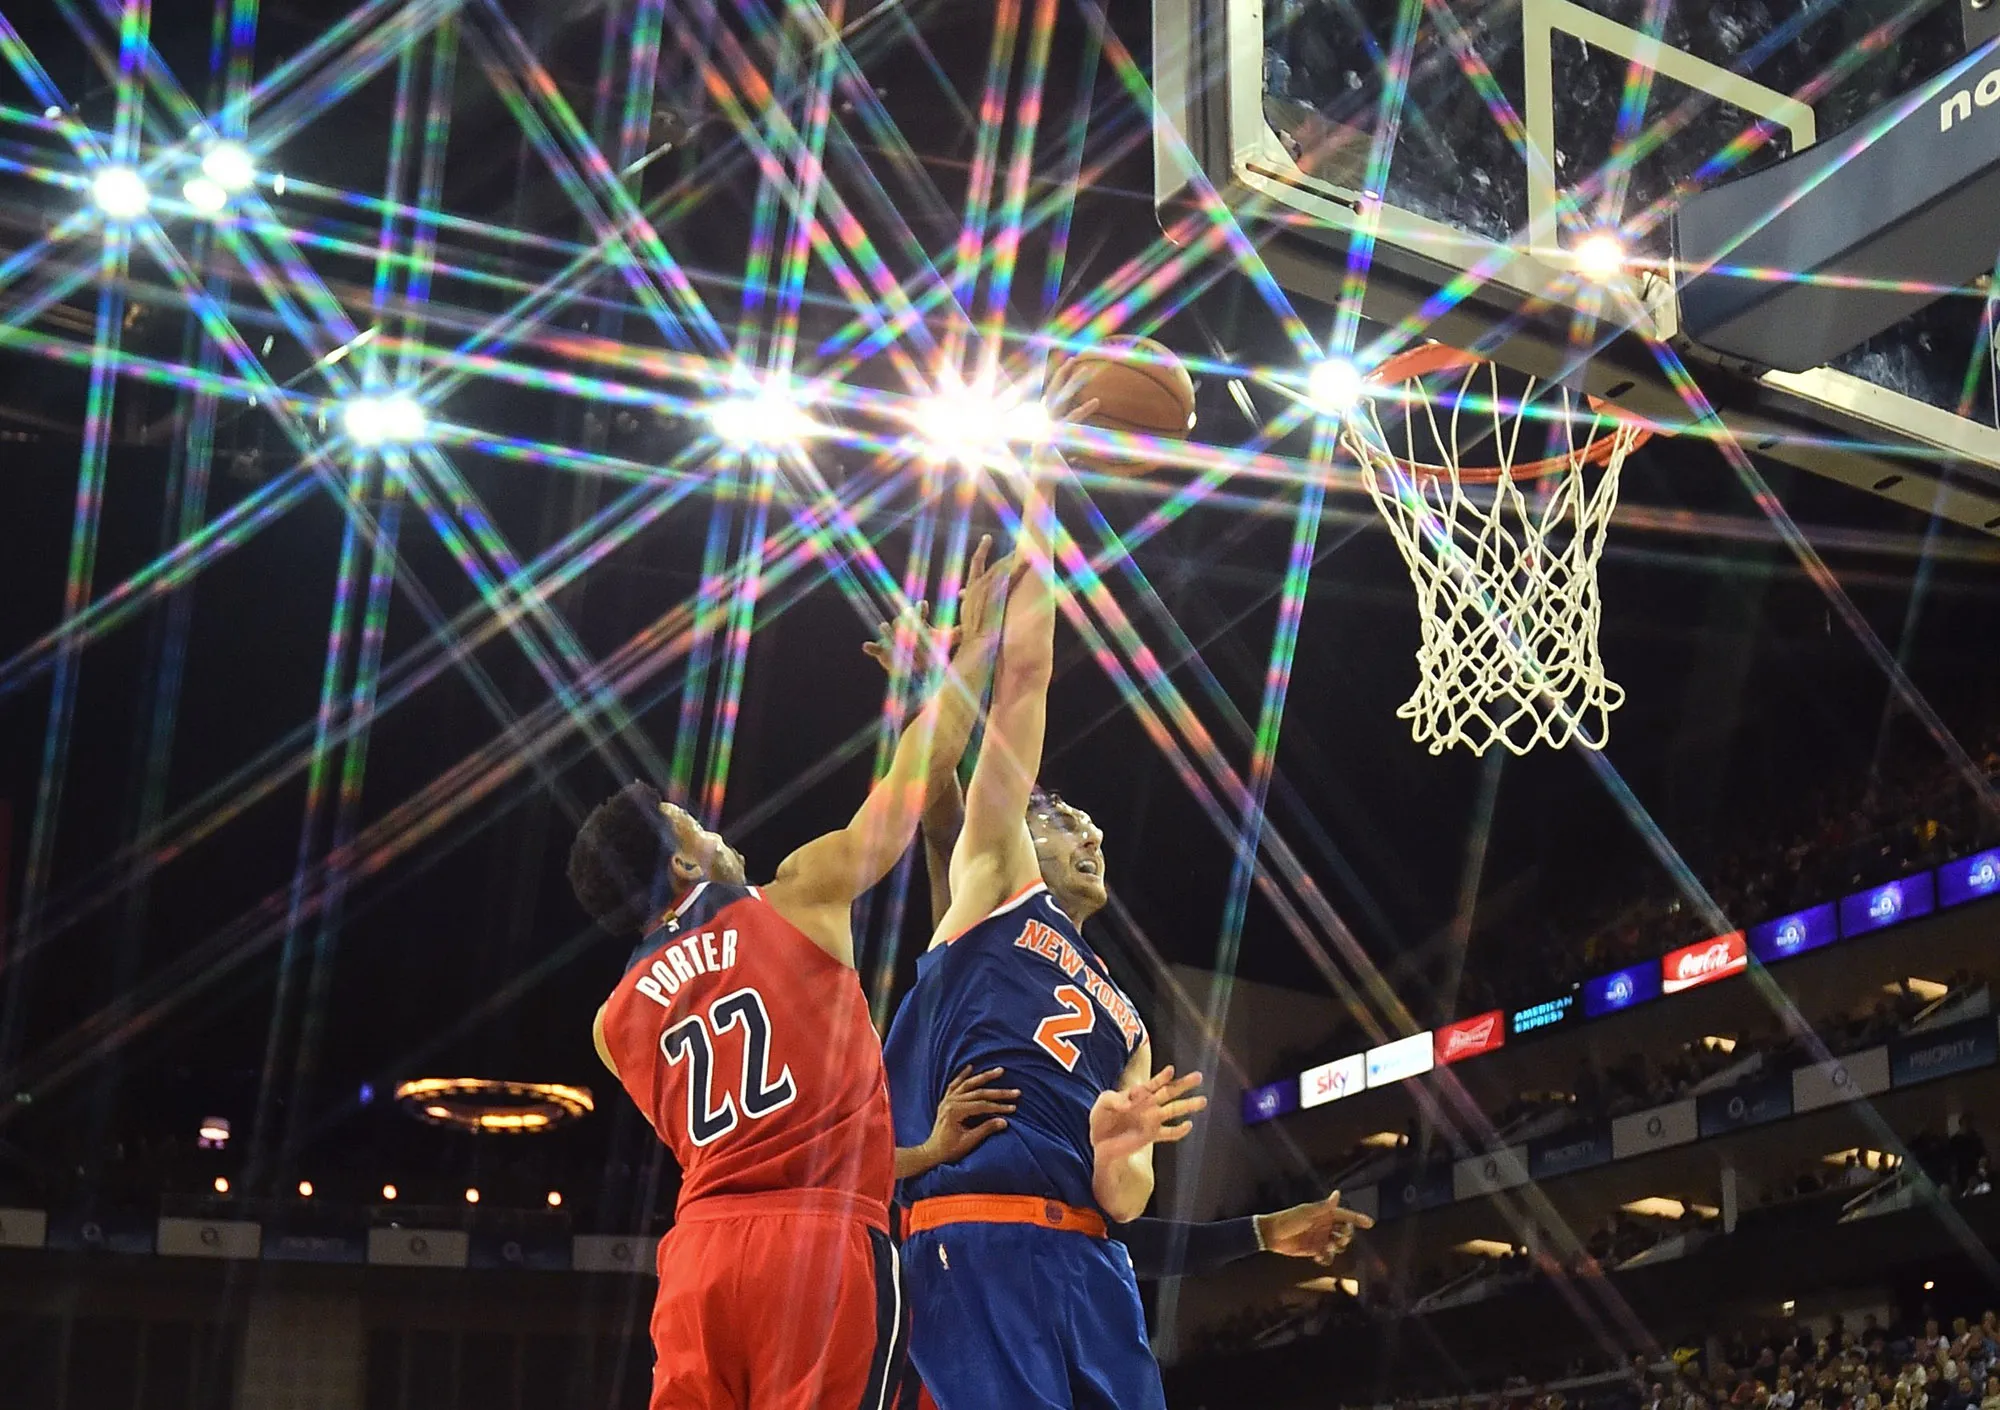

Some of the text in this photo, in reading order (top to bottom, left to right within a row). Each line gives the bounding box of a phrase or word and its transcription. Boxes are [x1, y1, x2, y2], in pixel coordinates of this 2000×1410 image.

[635, 929, 738, 1008] PORTER
[1014, 918, 1141, 1052] NEW YORK
[1514, 995, 1573, 1022] AMERICAN
[1033, 984, 1096, 1073] 2
[1514, 1009, 1564, 1035] EXPRESS
[660, 987, 797, 1147] 22
